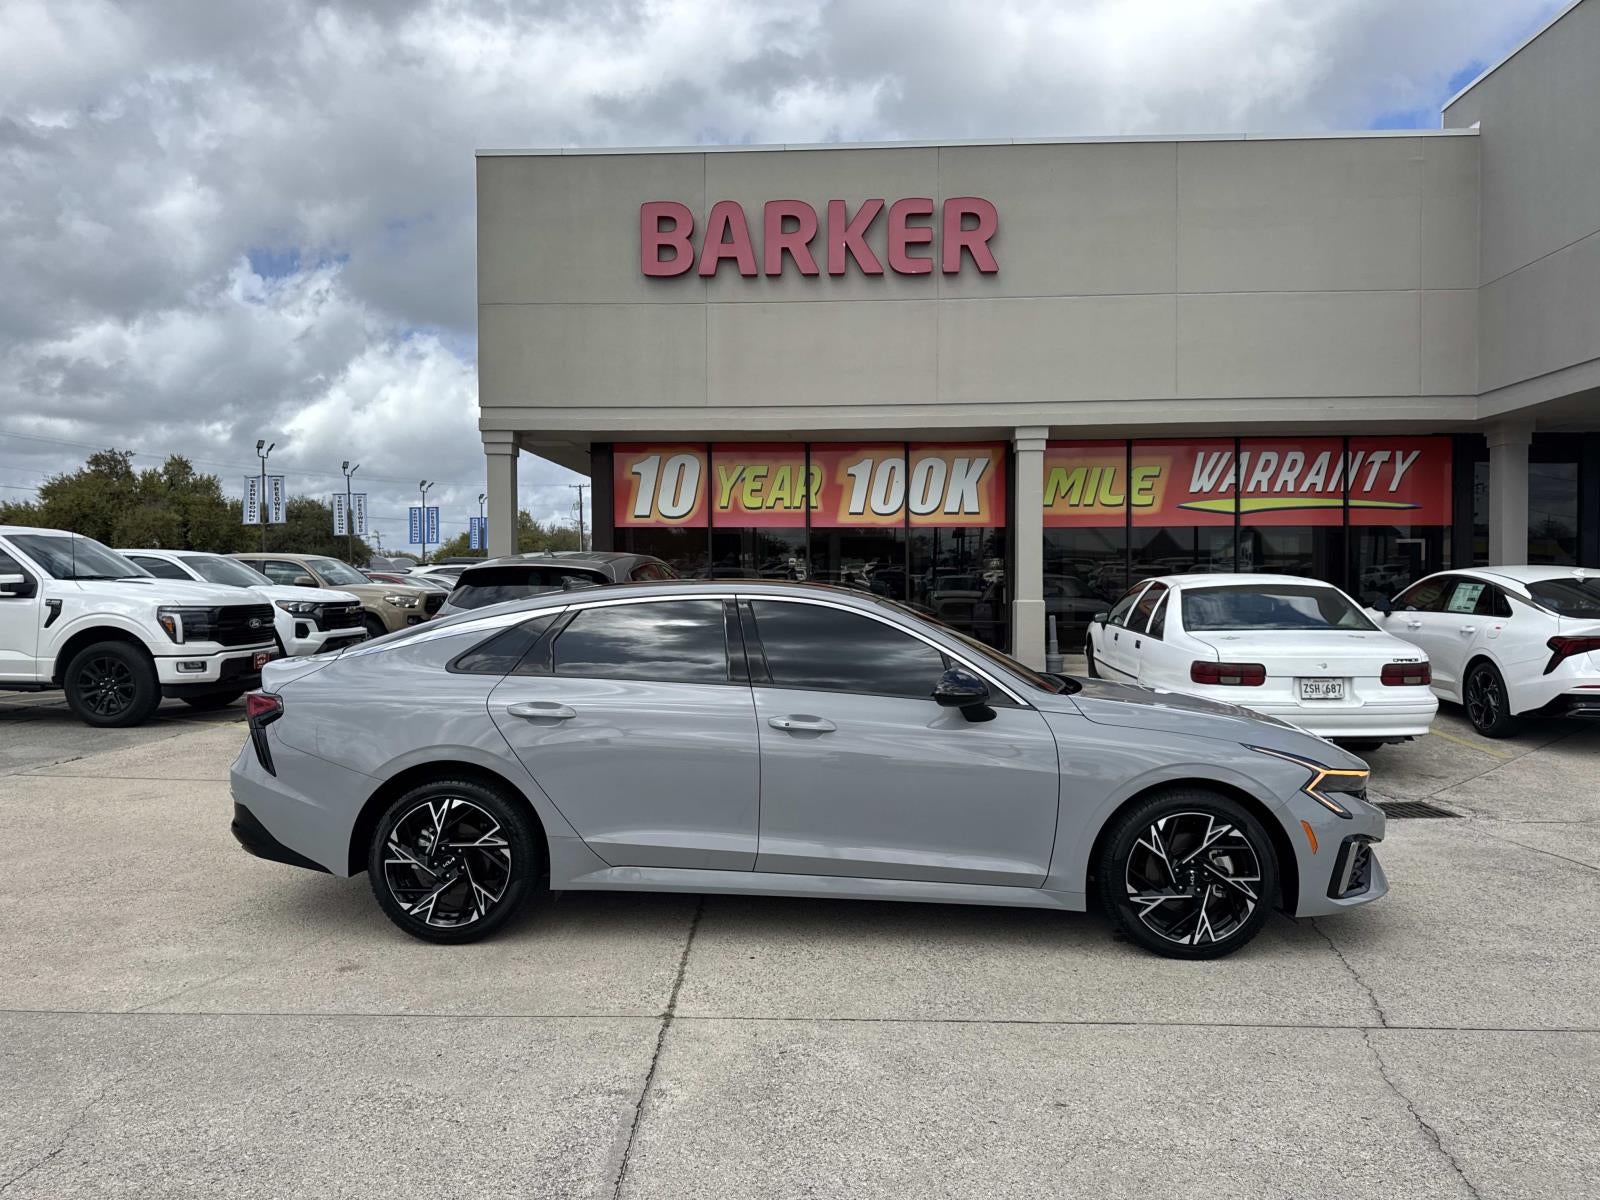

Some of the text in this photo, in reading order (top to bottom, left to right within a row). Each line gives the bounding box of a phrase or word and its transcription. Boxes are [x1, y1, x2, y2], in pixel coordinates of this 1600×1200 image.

[640, 197, 1000, 277] BARKER
[631, 449, 1422, 519] 10 YEAR 100K MILE WARRANTY
[1303, 683, 1342, 694] ZSH 687
